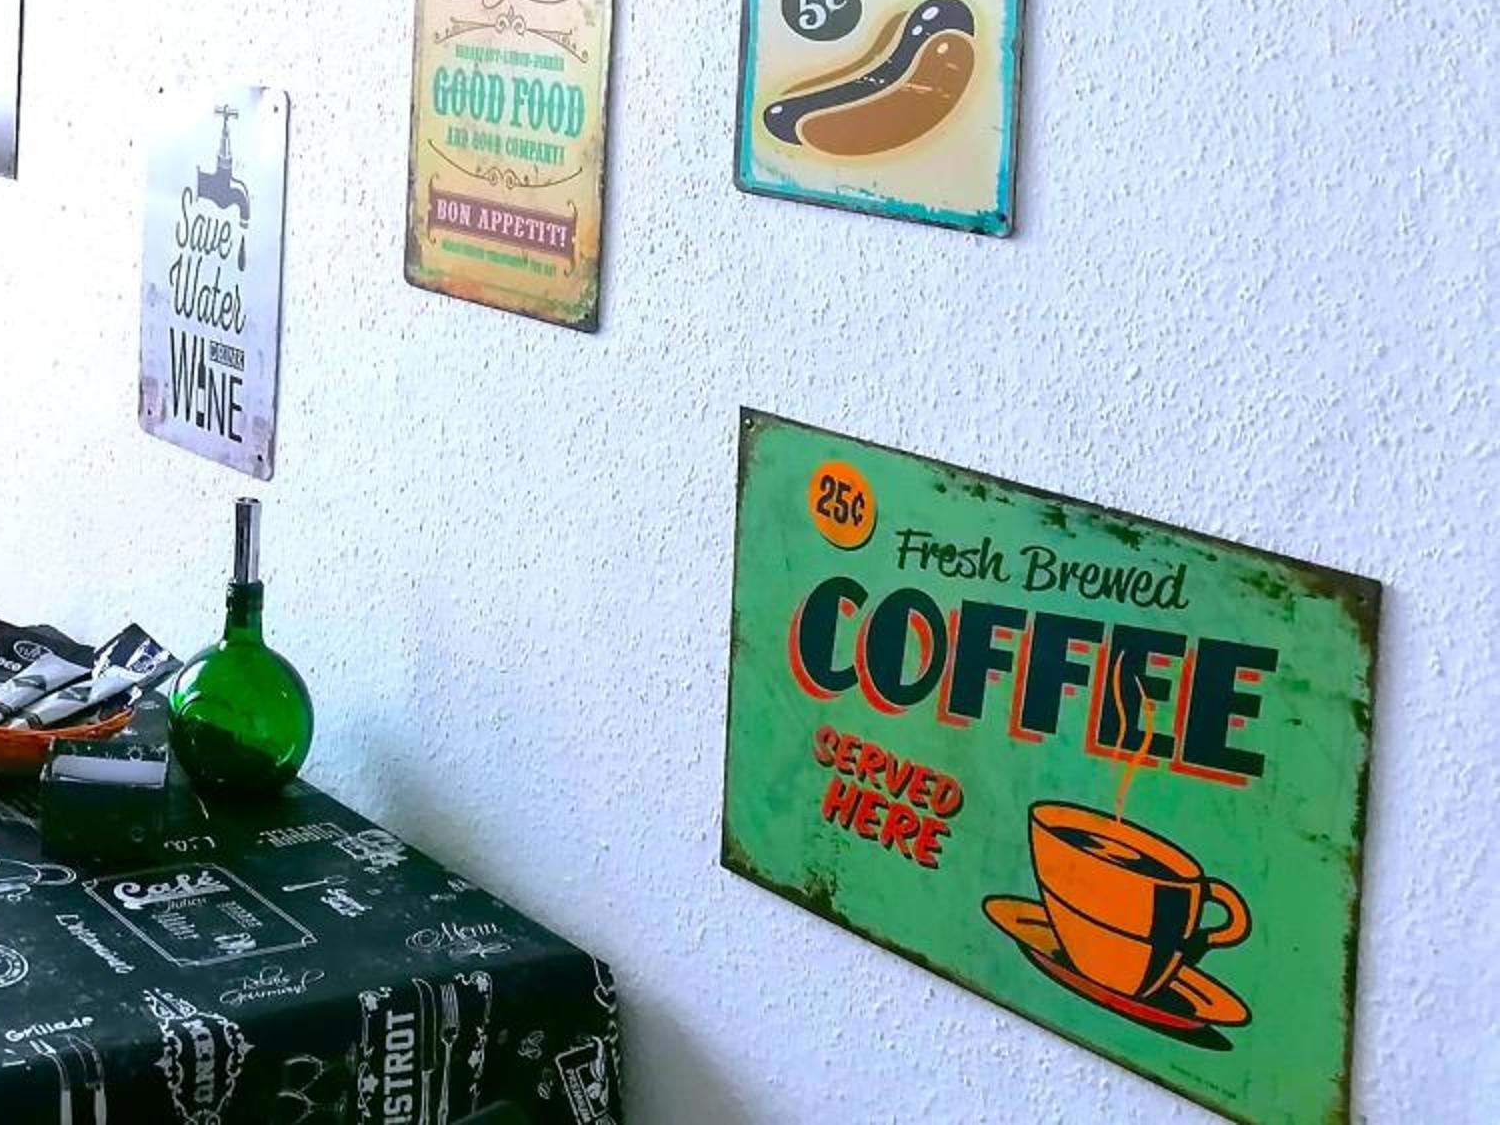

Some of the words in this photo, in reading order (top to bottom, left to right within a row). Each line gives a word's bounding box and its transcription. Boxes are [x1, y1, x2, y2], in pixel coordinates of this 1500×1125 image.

[432, 66, 504, 124] GOOD
[510, 78, 585, 138] FOOD
[175, 186, 233, 260] Save
[436, 198, 470, 226] BON
[477, 208, 567, 248] APPETIT!
[169, 255, 246, 334] Water
[815, 473, 866, 529] 25¢
[895, 528, 1010, 583] Fresh
[1020, 546, 1190, 611] Brewed
[788, 576, 1279, 788] COFFEE
[814, 724, 964, 818] SERVED
[821, 781, 954, 868] HERE
